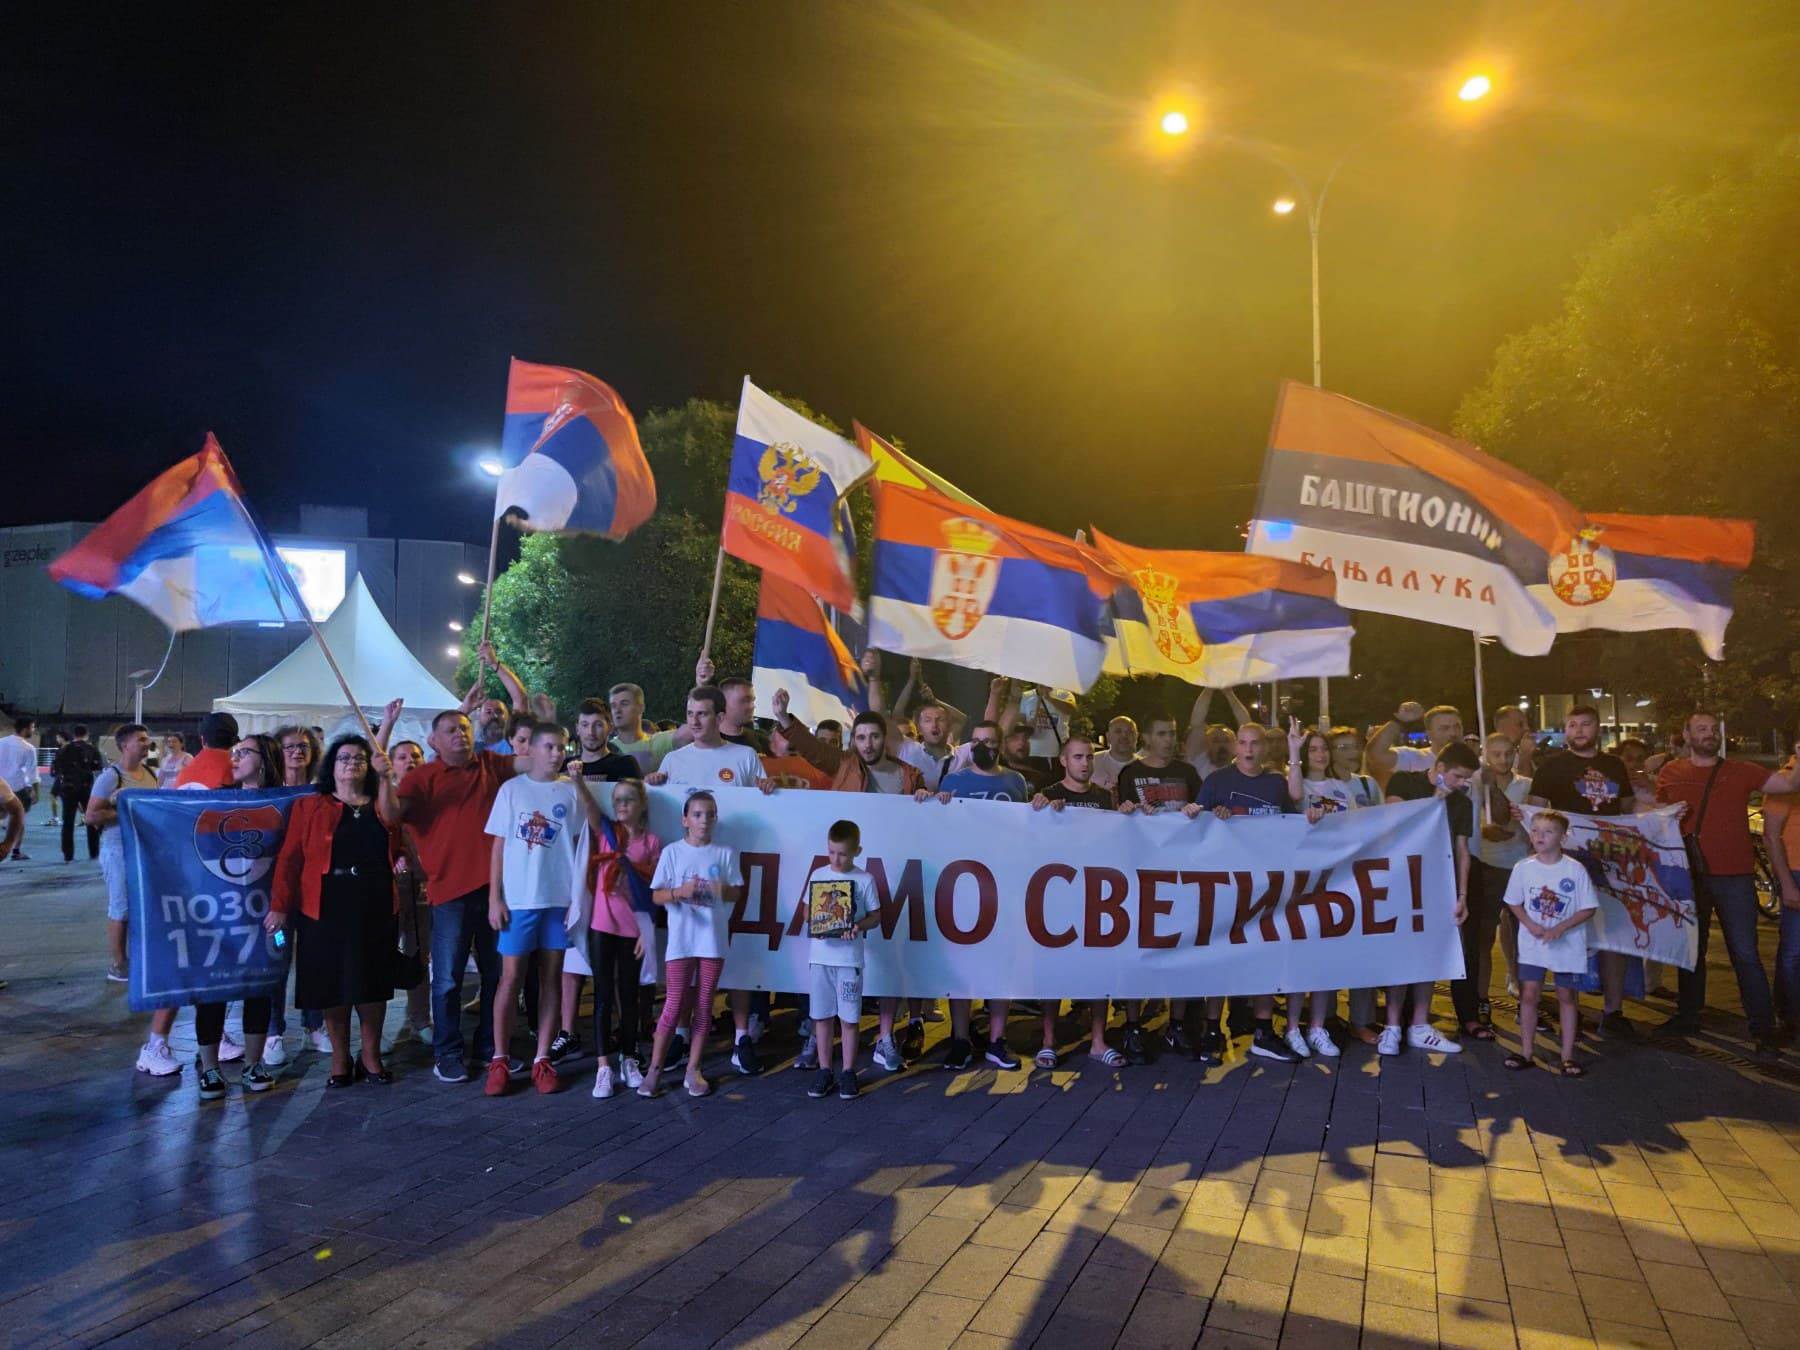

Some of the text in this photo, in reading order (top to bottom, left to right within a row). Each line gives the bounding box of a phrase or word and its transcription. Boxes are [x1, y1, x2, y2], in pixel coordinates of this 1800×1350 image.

[161, 889, 270, 924] ПОЗО
[728, 852, 1425, 952] ДМО СВЕТИЊЕ!
